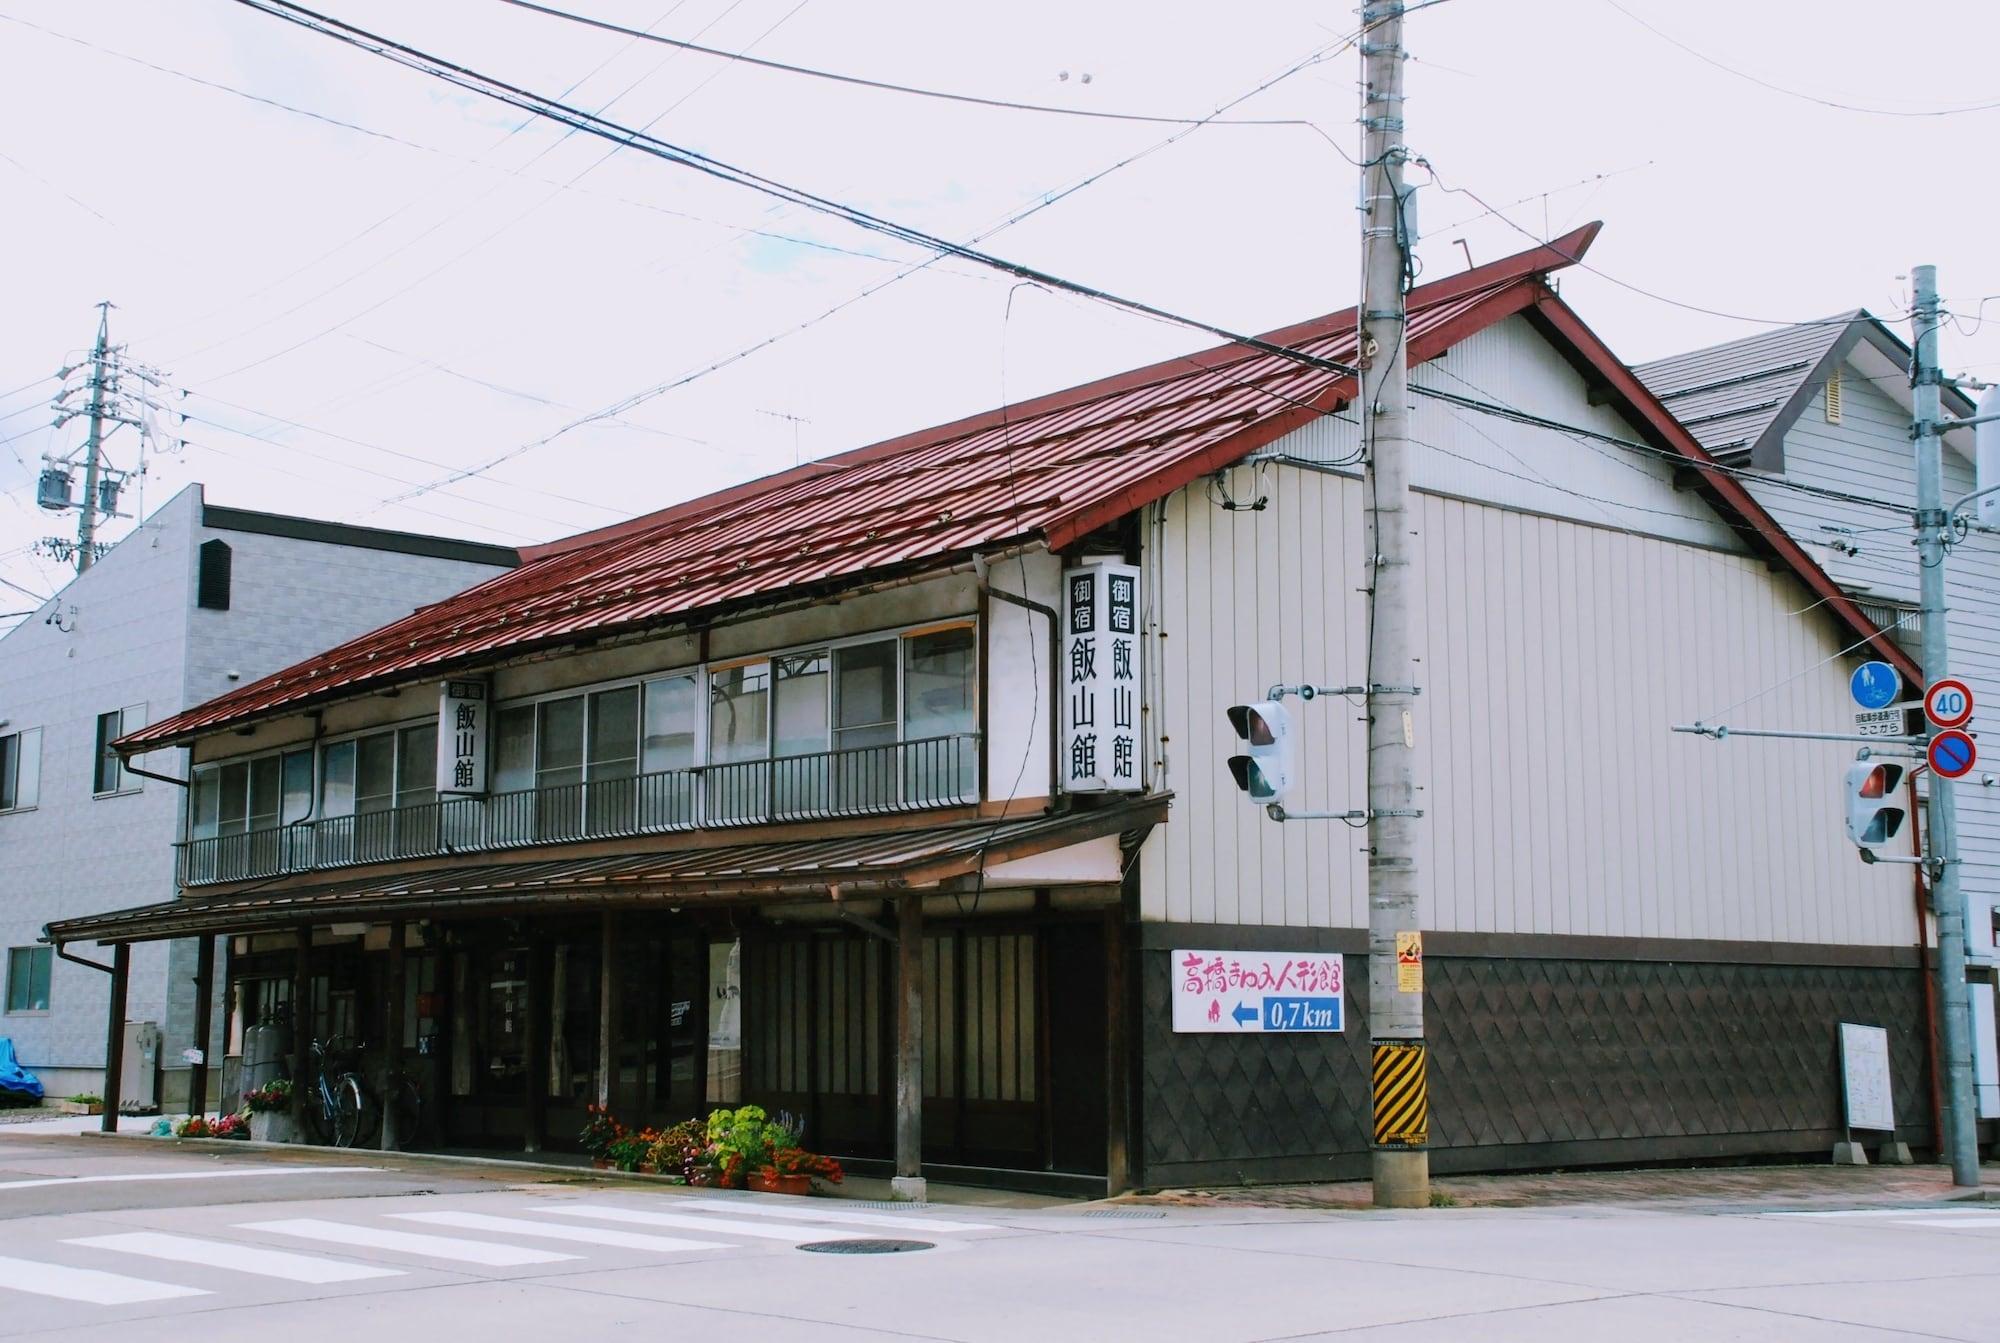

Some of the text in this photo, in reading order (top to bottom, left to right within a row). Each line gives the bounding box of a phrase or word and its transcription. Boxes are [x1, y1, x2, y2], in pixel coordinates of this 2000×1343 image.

[1069, 579, 1098, 782] 御宿 飯山館
[1111, 579, 1134, 779] 御宿 飯山館
[1936, 693, 1963, 714] 40
[454, 702, 476, 788] 飯山館
[1859, 723, 1899, 736] ここから
